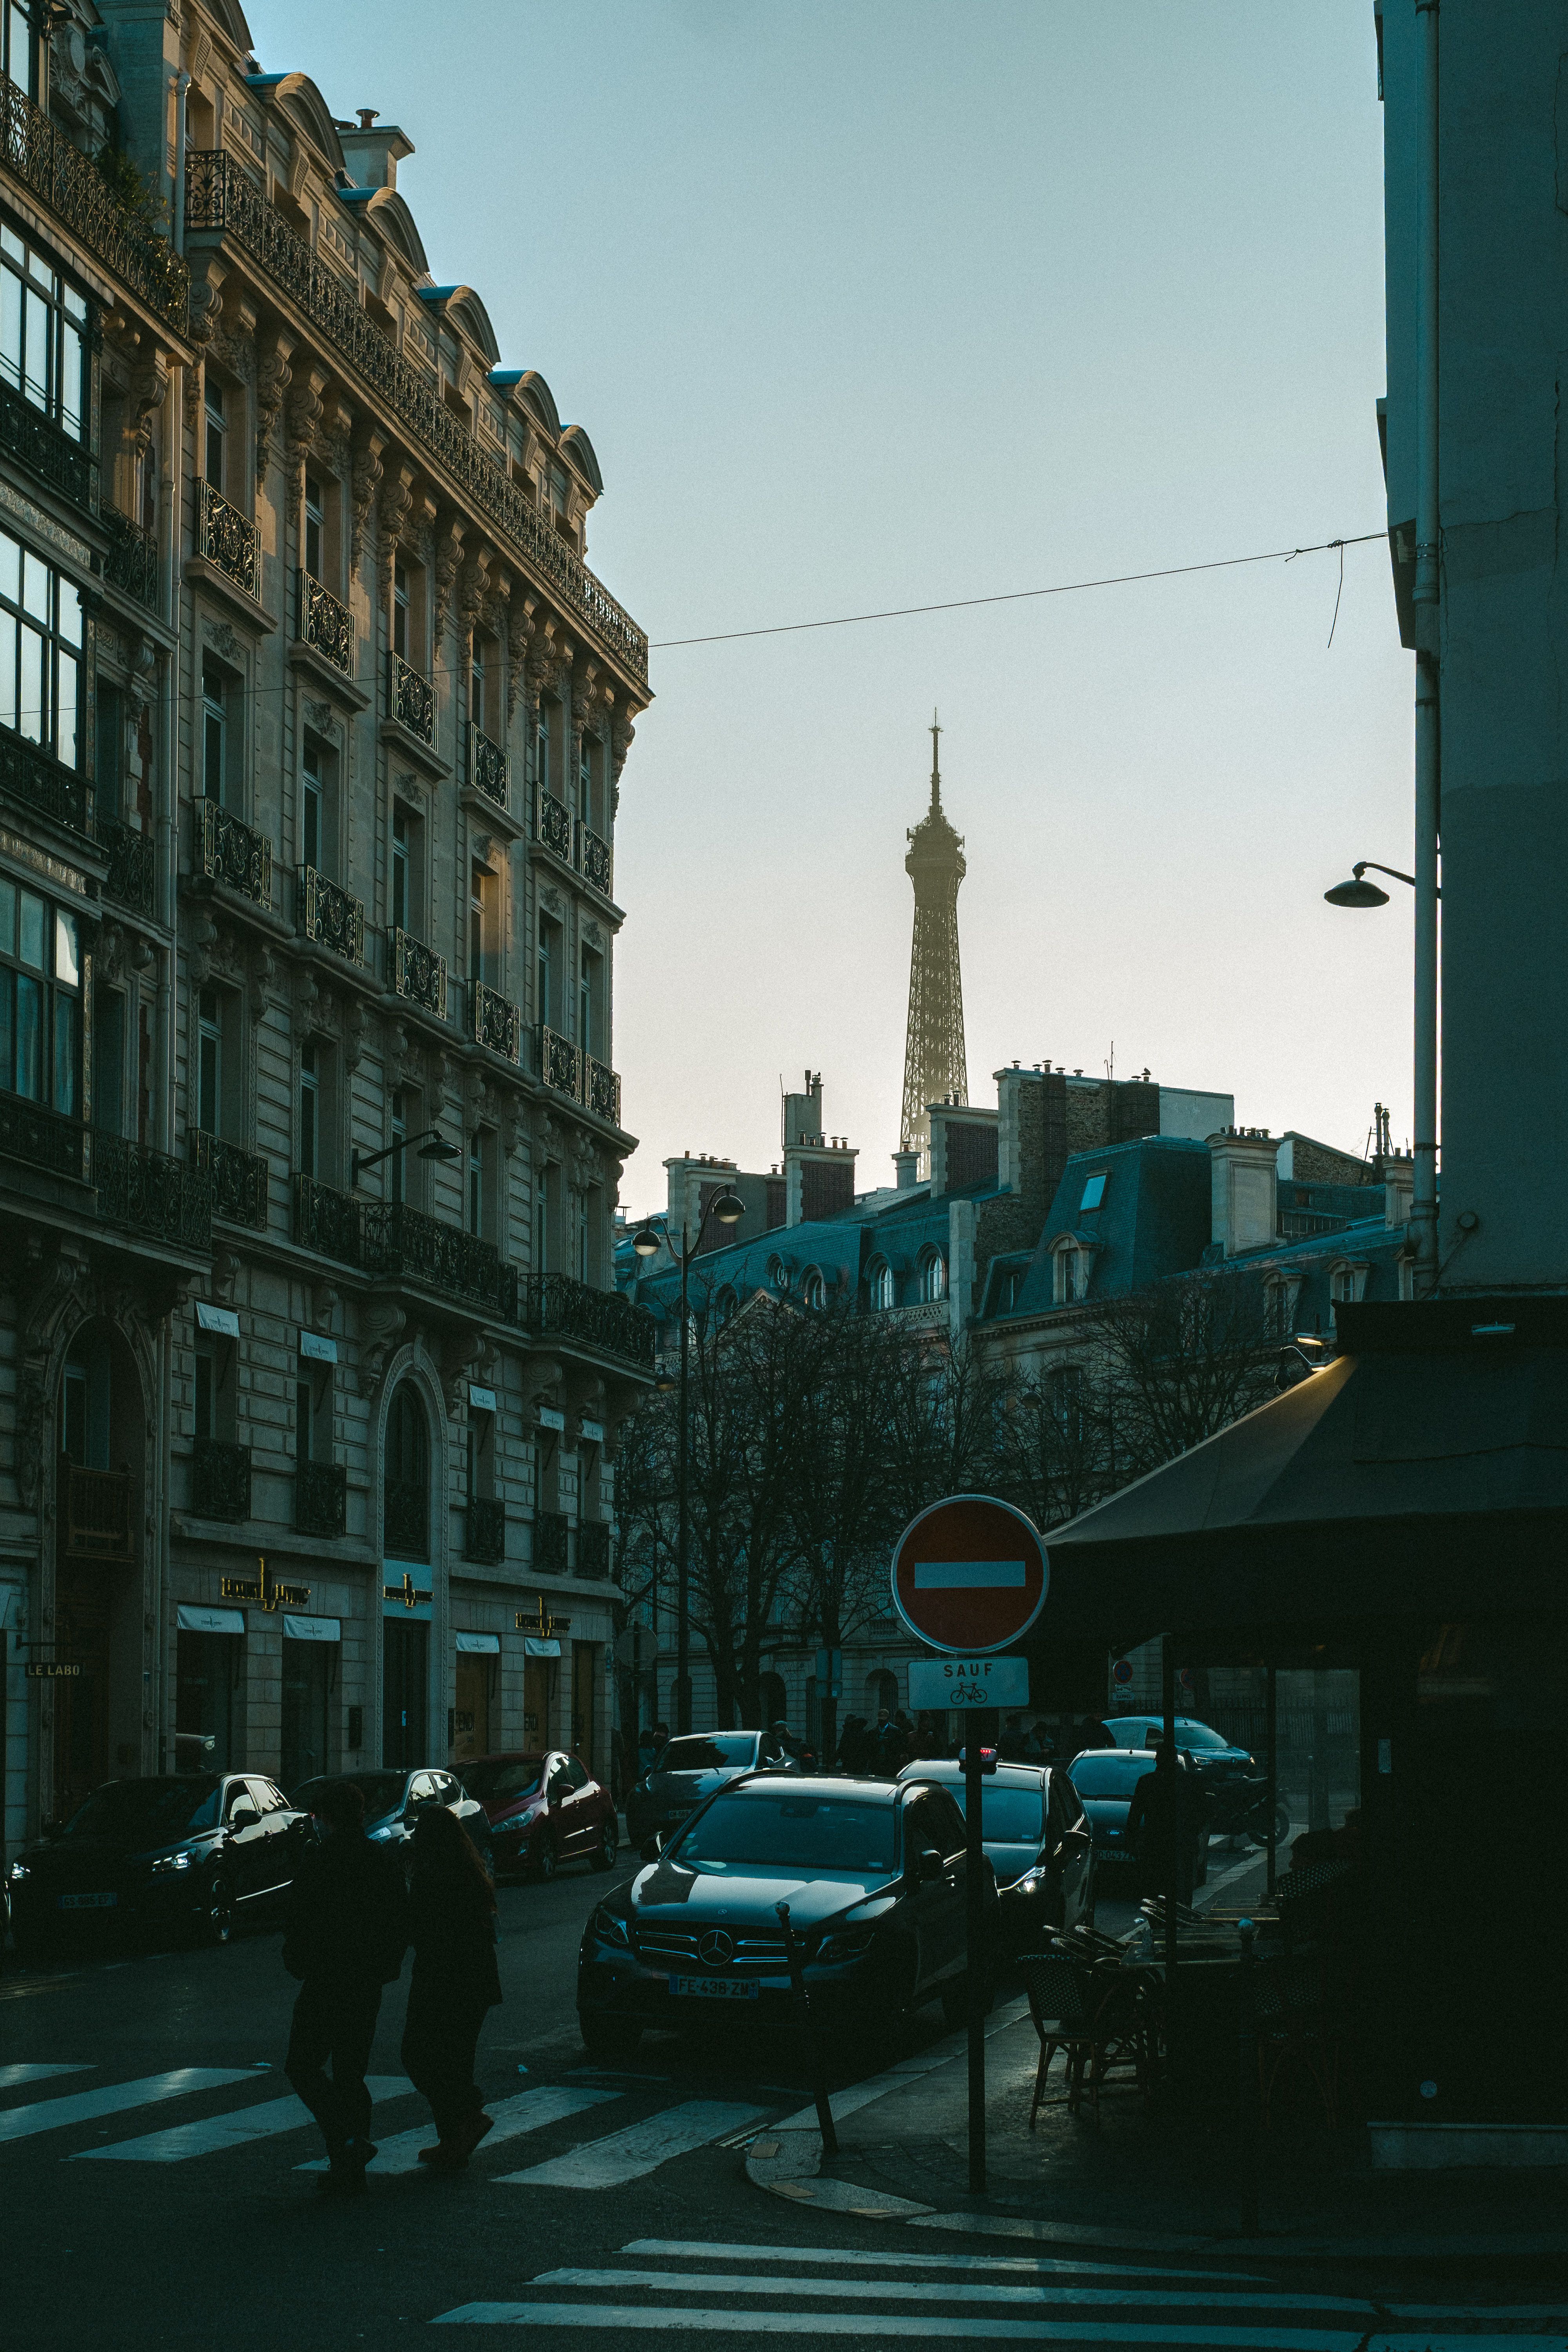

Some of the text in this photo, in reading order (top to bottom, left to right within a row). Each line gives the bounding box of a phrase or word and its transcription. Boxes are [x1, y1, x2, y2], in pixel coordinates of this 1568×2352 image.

[28, 1665, 80, 1676] LE LABO
[944, 1663, 993, 1678] SAUF
[679, 1978, 750, 1996] FE-438-ZM
